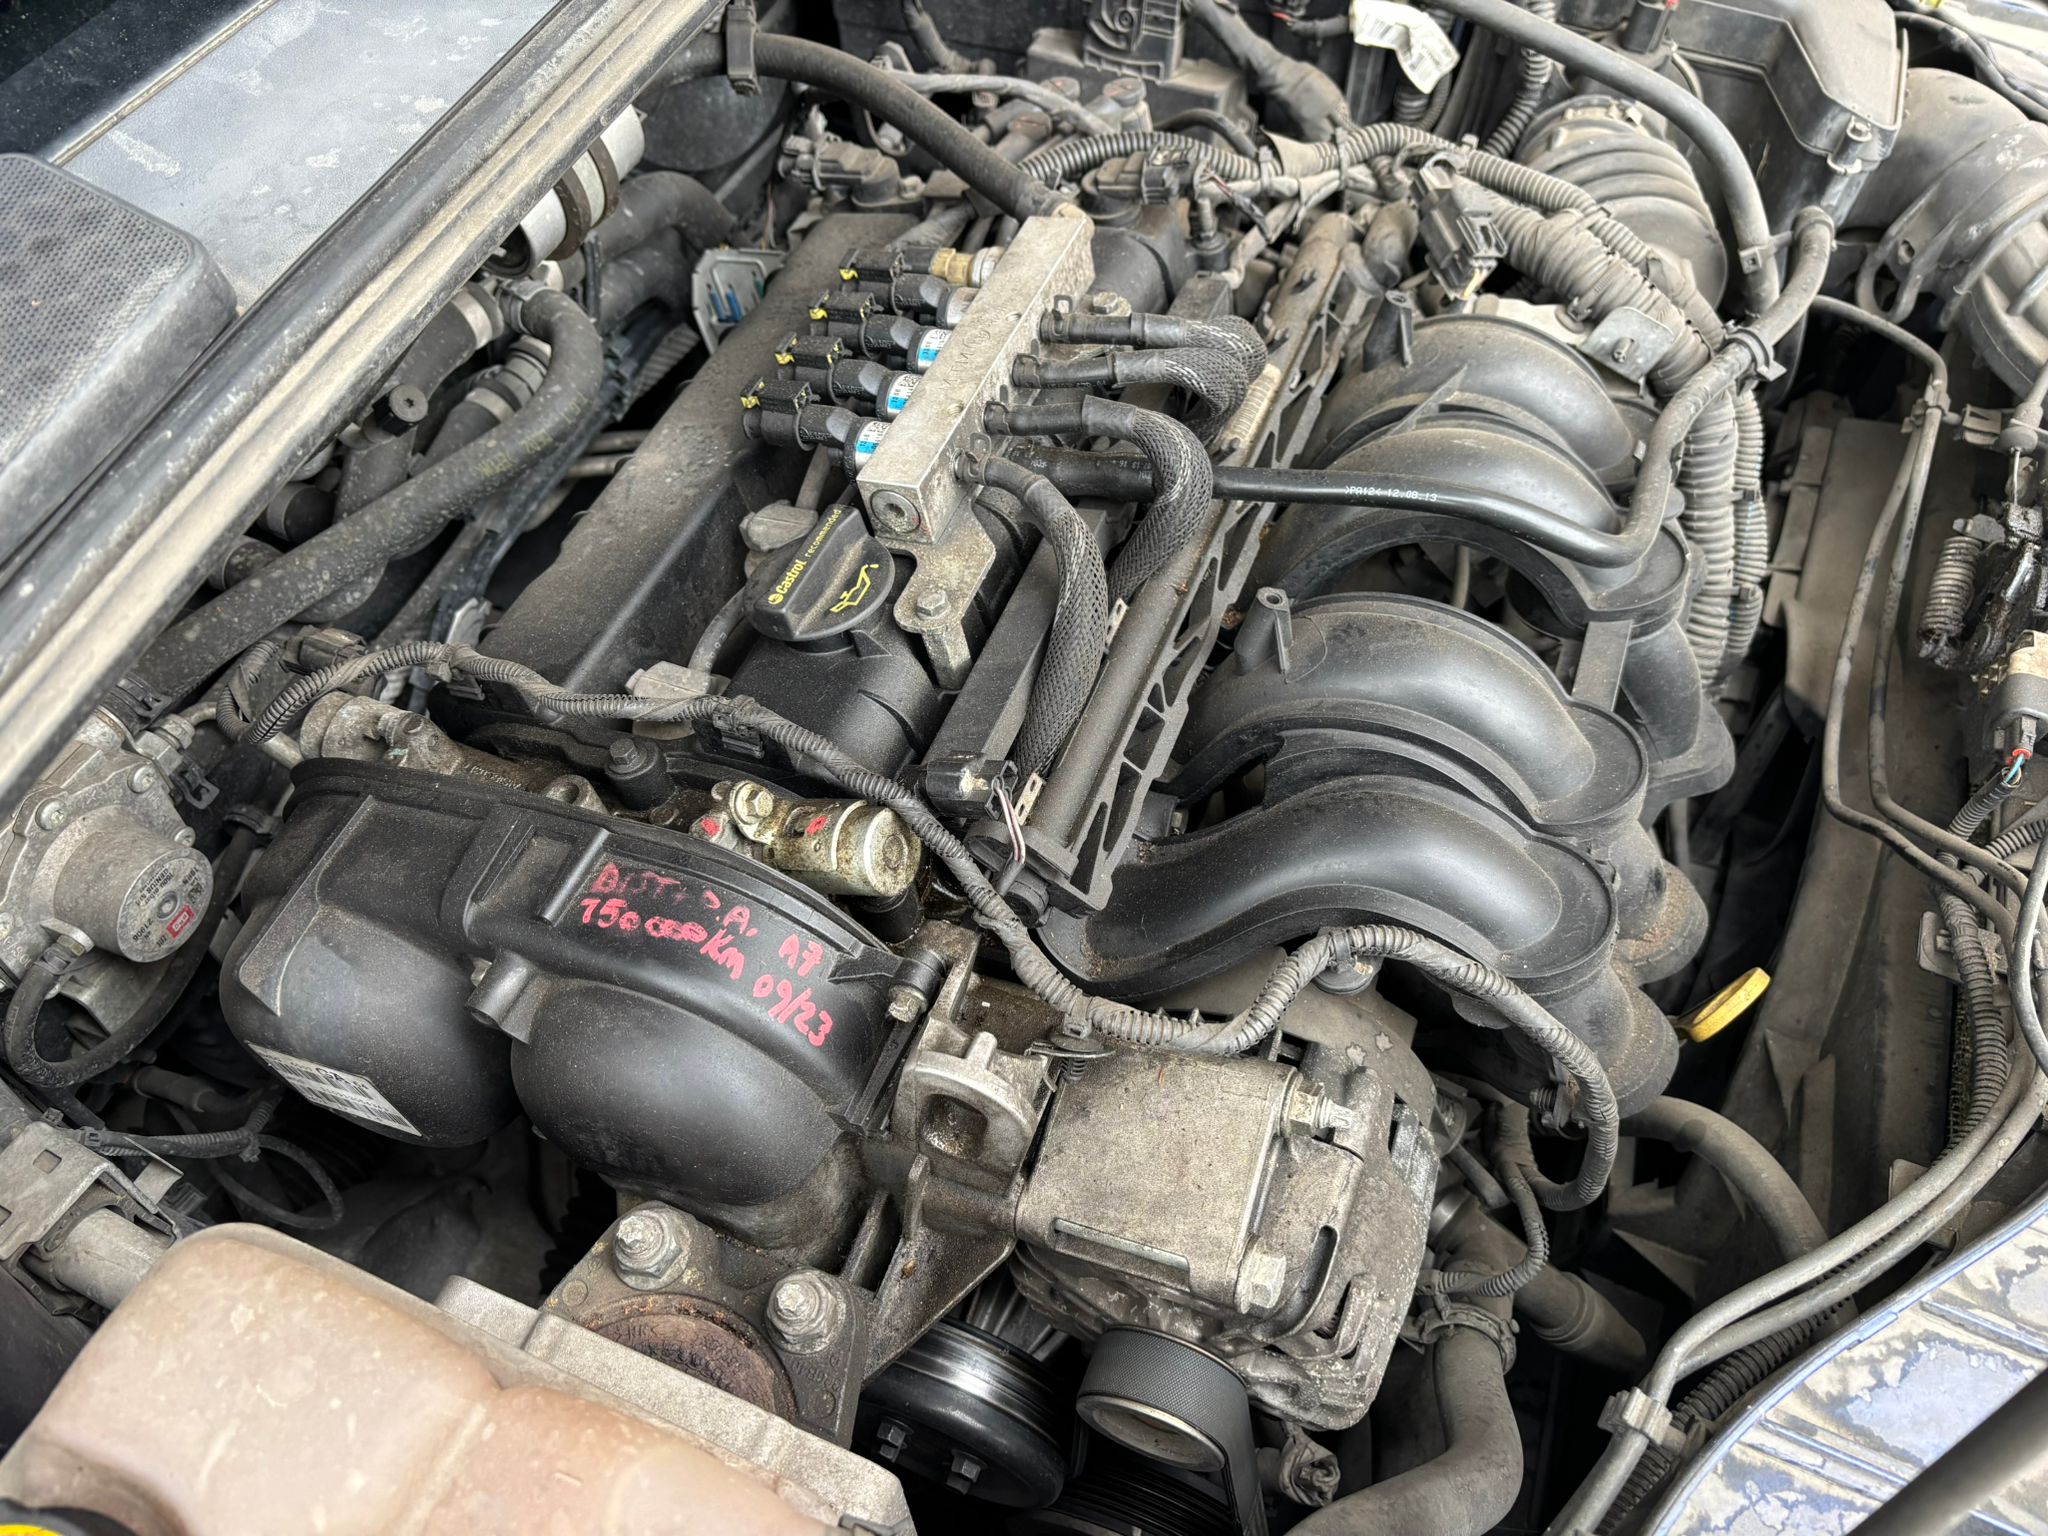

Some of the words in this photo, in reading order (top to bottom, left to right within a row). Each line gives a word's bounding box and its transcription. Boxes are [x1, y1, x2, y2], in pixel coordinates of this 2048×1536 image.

[775, 559, 807, 595] Castrol
[805, 508, 842, 558] recommended
[752, 974, 833, 1047] 09/23
